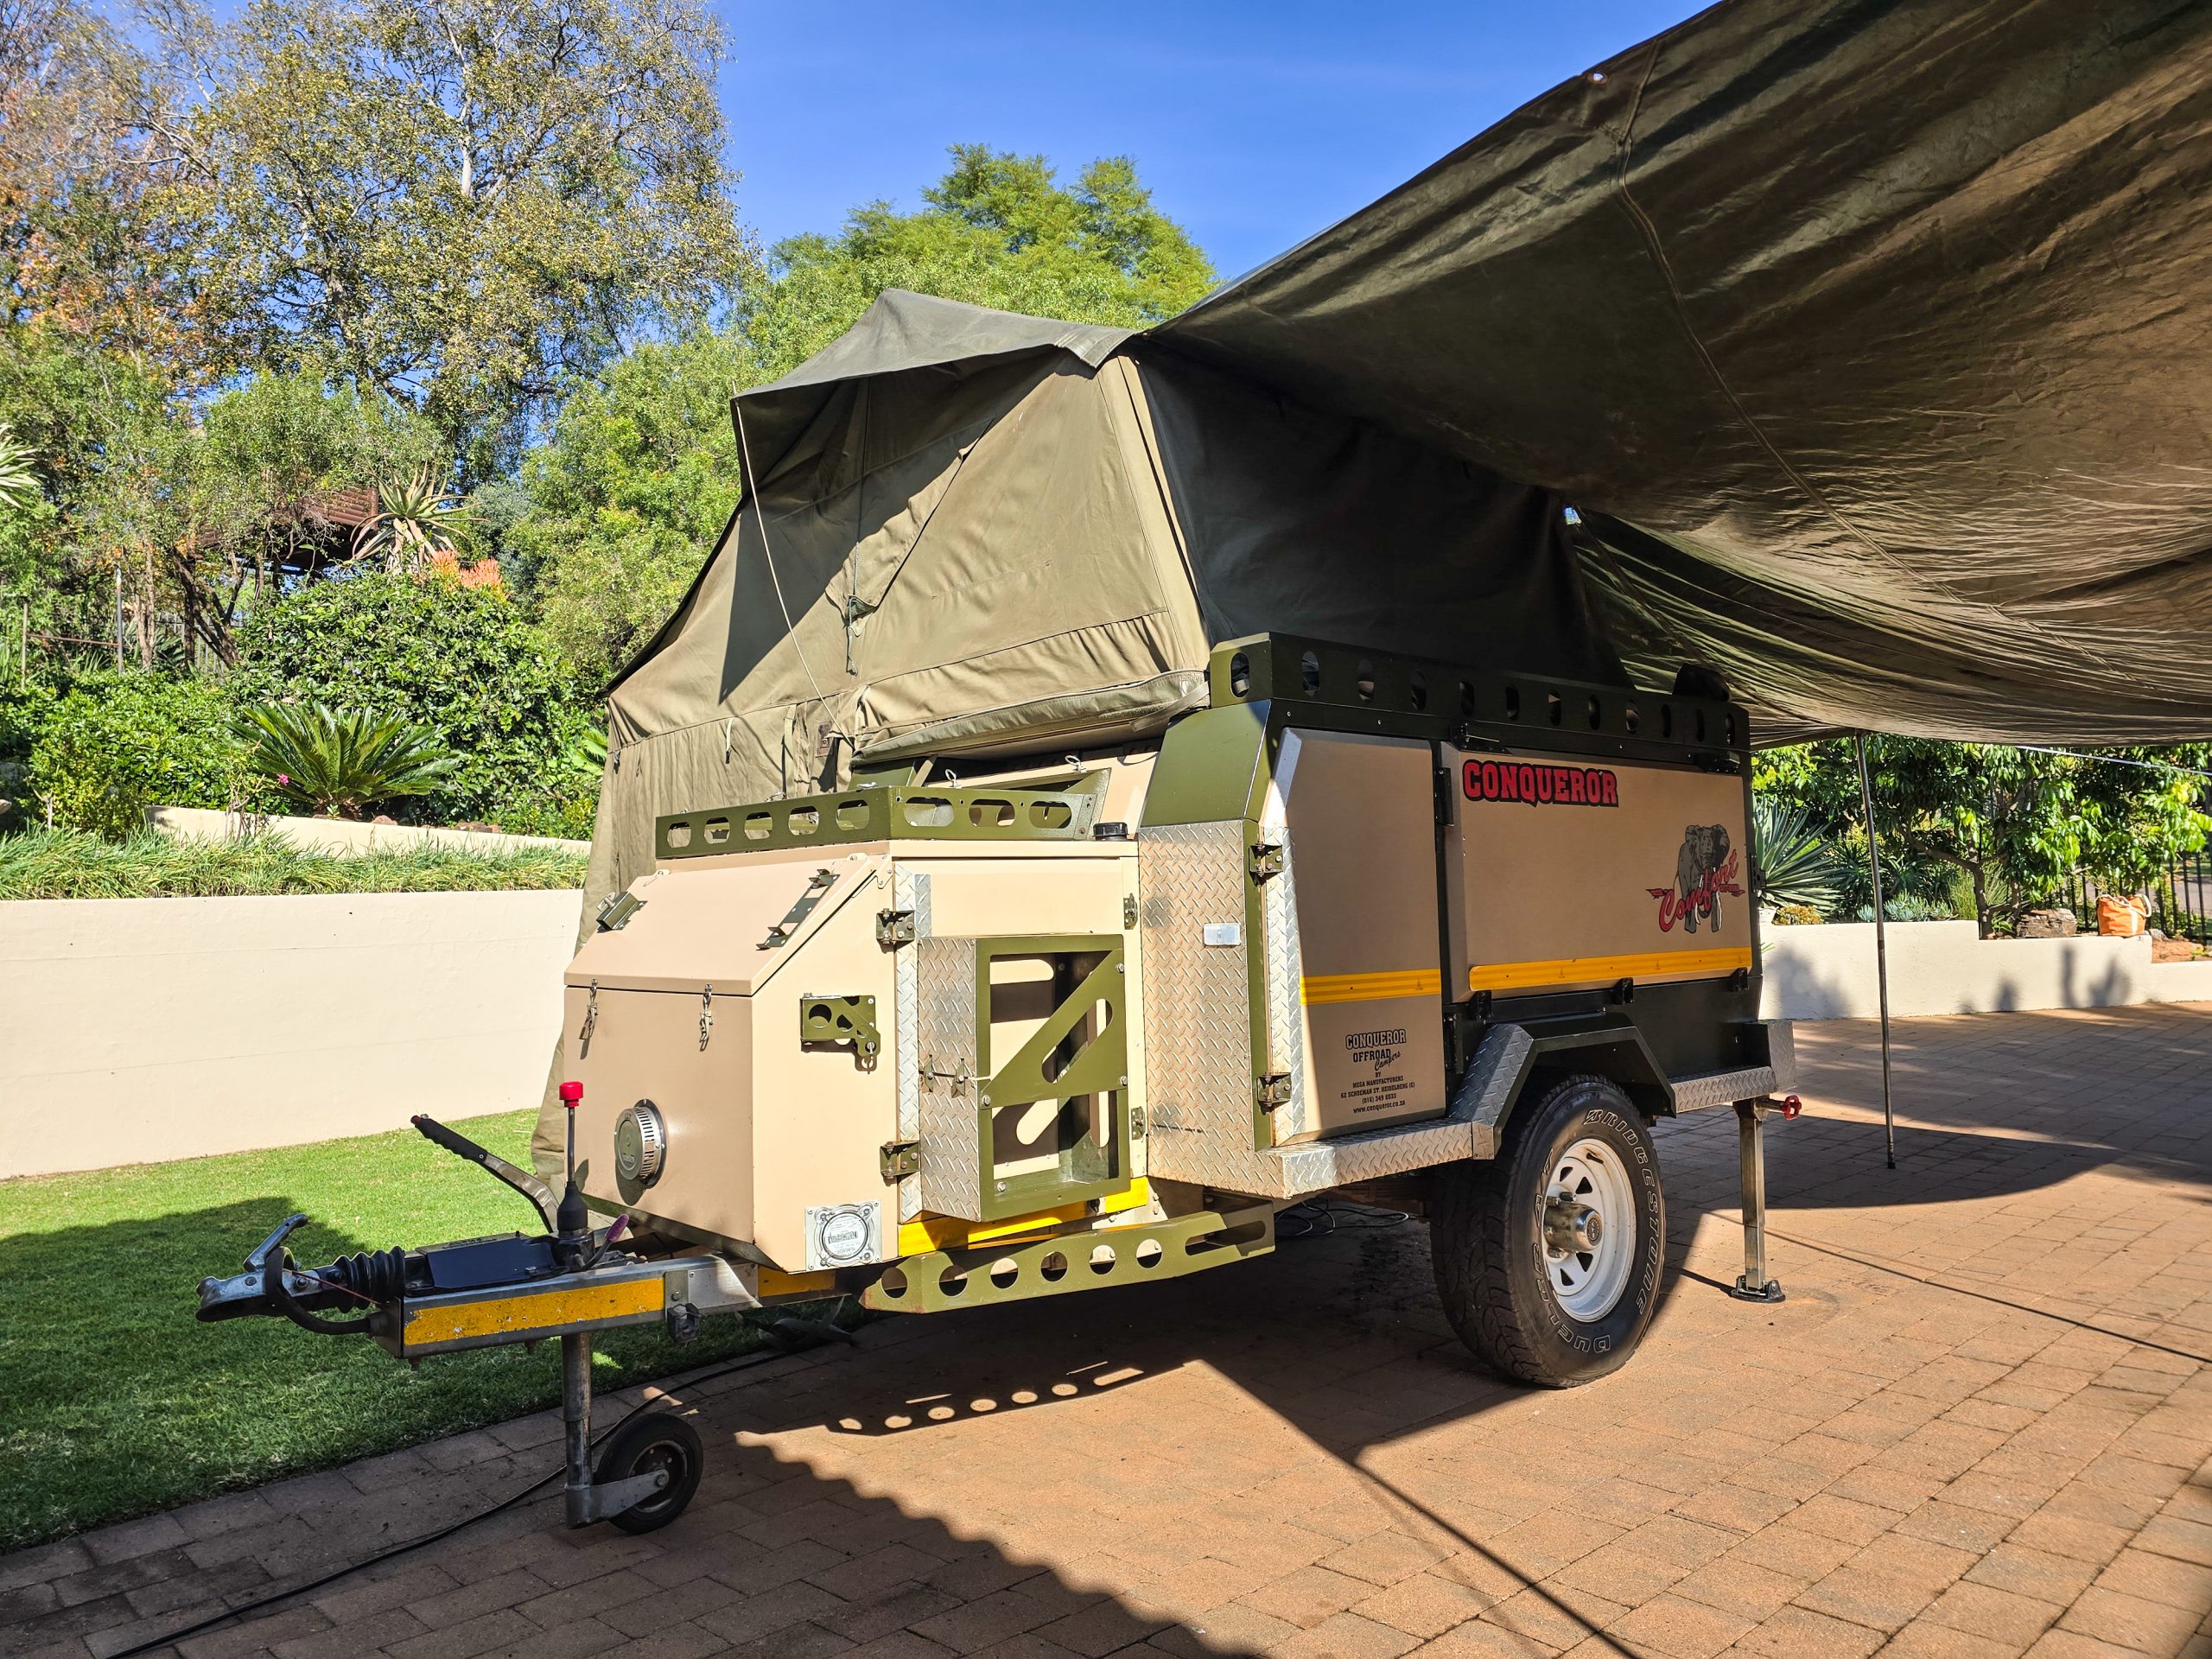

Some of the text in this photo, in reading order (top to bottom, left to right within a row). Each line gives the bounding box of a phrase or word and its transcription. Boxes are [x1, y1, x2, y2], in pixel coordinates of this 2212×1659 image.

[1463, 760, 1618, 807] CONQUEROR
[1659, 849, 1738, 932] Comfort
[1345, 1029, 1407, 1050] CONQUEROR
[1353, 1049, 1391, 1063] OFFROAD
[1375, 1051, 1401, 1071] Campers
[1366, 1076, 1403, 1086] MANUFACTURERS
[1382, 1084, 1408, 1092] HEIDELBERG
[1583, 1109, 1660, 1315] BRIDGESTONE
